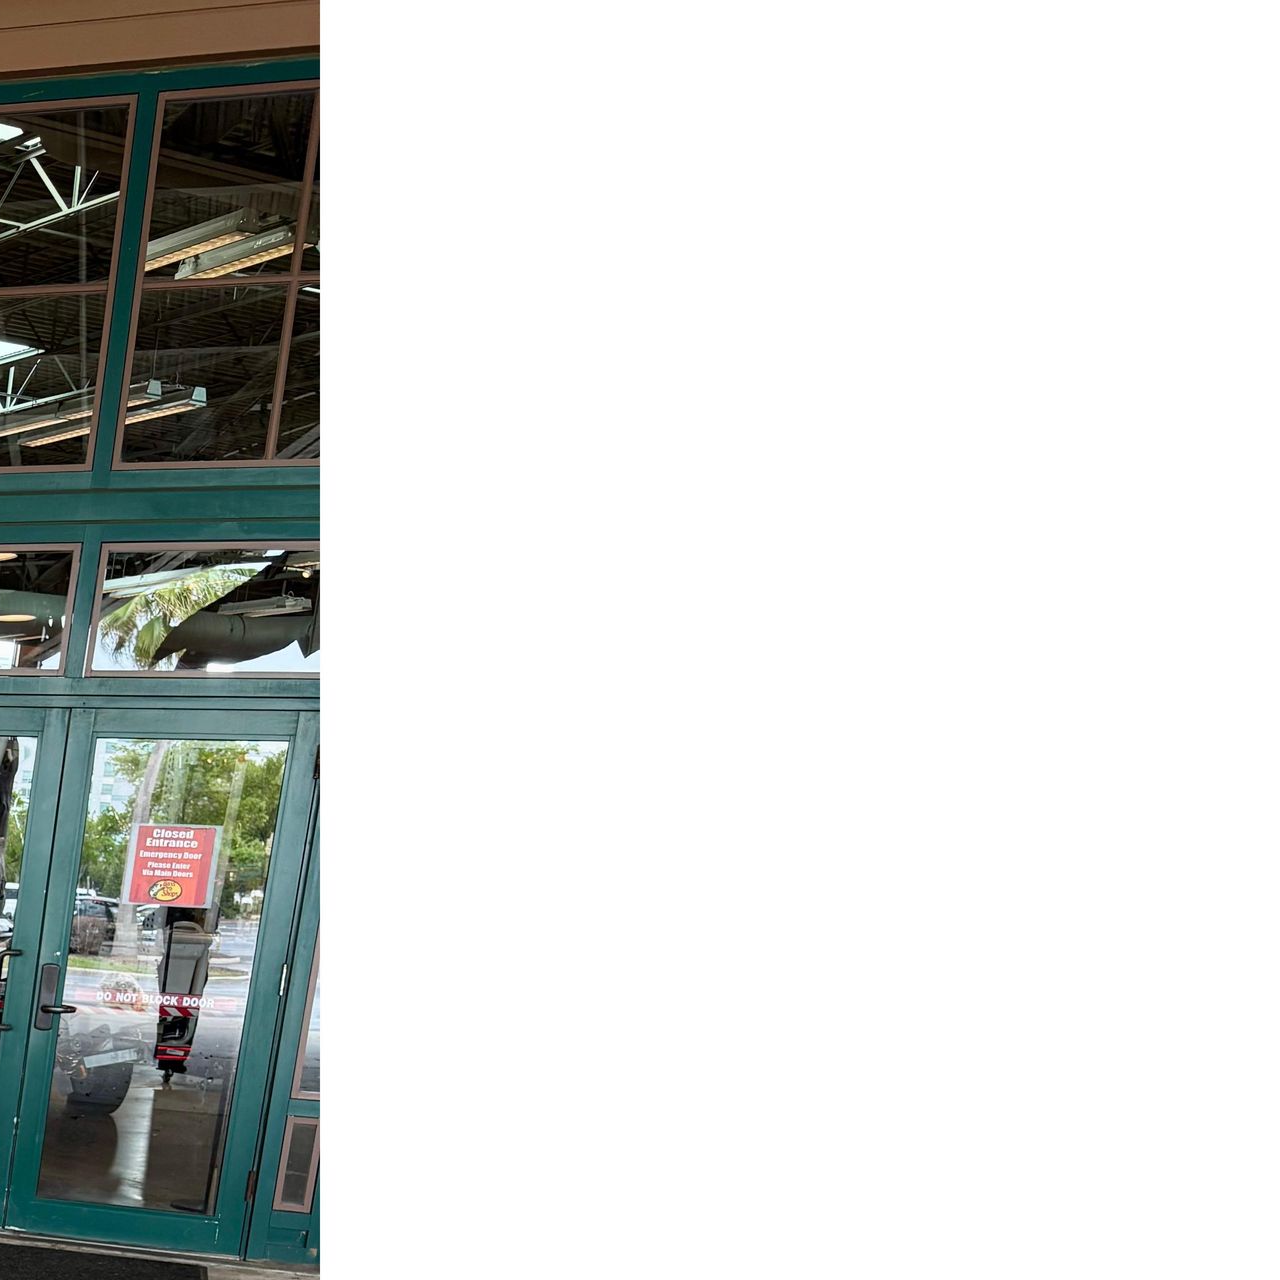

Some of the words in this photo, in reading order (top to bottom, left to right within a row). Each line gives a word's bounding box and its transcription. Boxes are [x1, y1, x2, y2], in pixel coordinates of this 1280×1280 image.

[152, 828, 195, 839] Closed
[145, 838, 199, 849] Entrance
[139, 850, 183, 860] Emergency
[182, 851, 203, 860] Door
[147, 861, 171, 869] Please
[171, 862, 191, 870] Enter
[154, 869, 172, 877] Main
[172, 870, 194, 878] Doors
[96, 991, 112, 1001] DO
[115, 992, 139, 1003] NOT
[142, 994, 179, 1006] BLOCK
[182, 997, 215, 1009] DOOR
